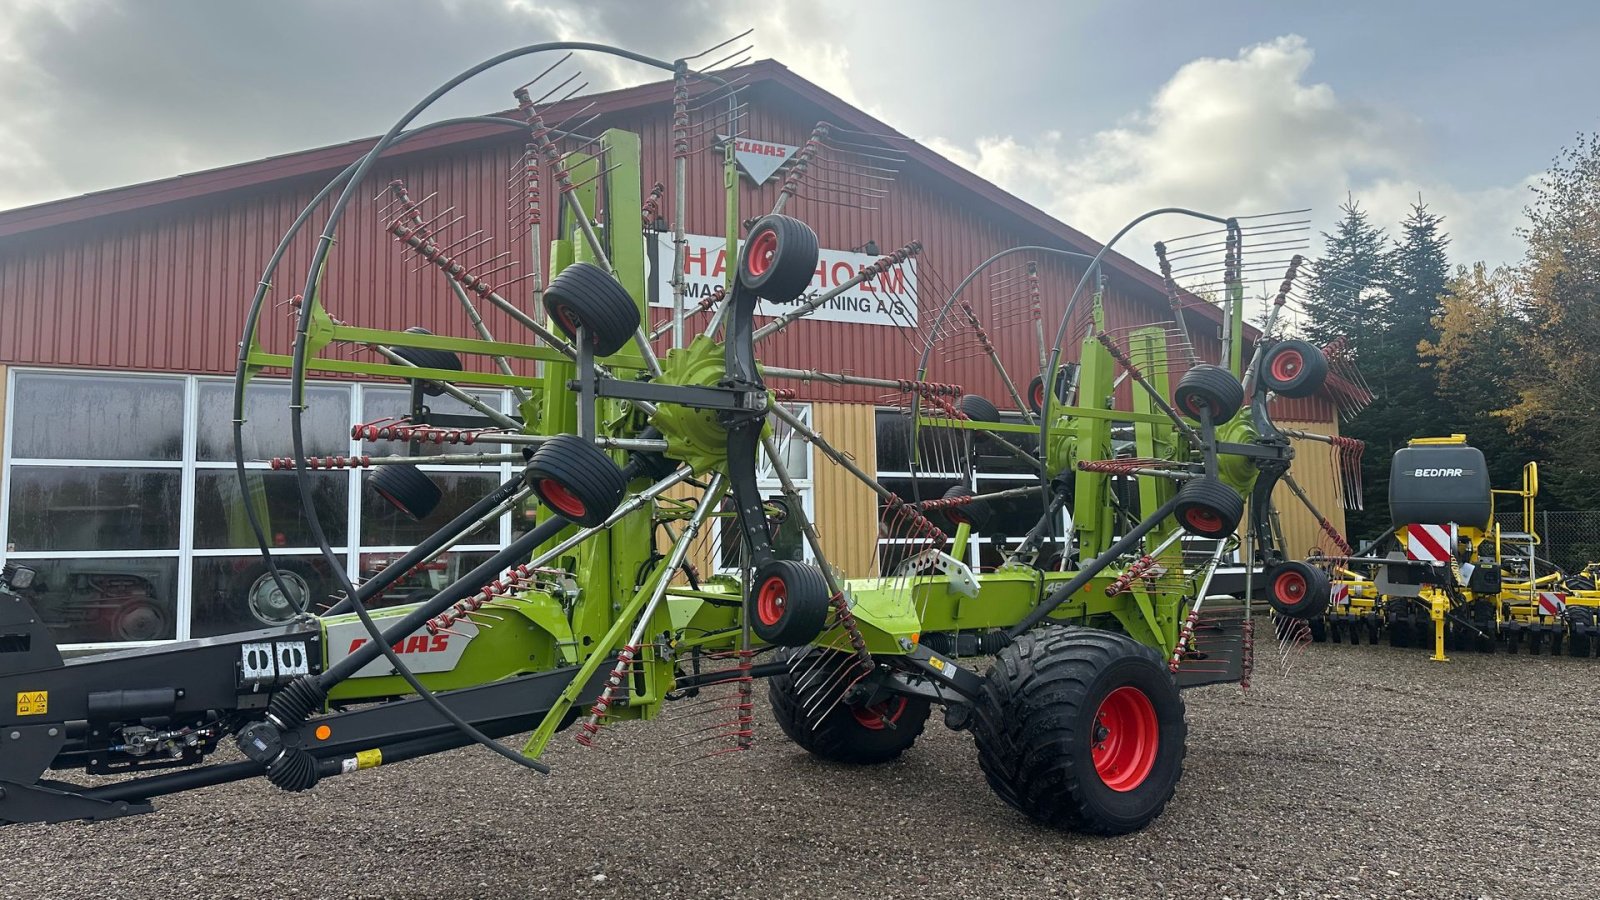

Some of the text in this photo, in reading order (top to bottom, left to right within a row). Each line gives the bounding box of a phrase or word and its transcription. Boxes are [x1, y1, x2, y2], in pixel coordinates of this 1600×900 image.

[735, 141, 785, 157] CLAAS
[876, 299, 905, 316] A/S
[1415, 468, 1463, 477] BEDNAR
[348, 634, 450, 655] CAAS
